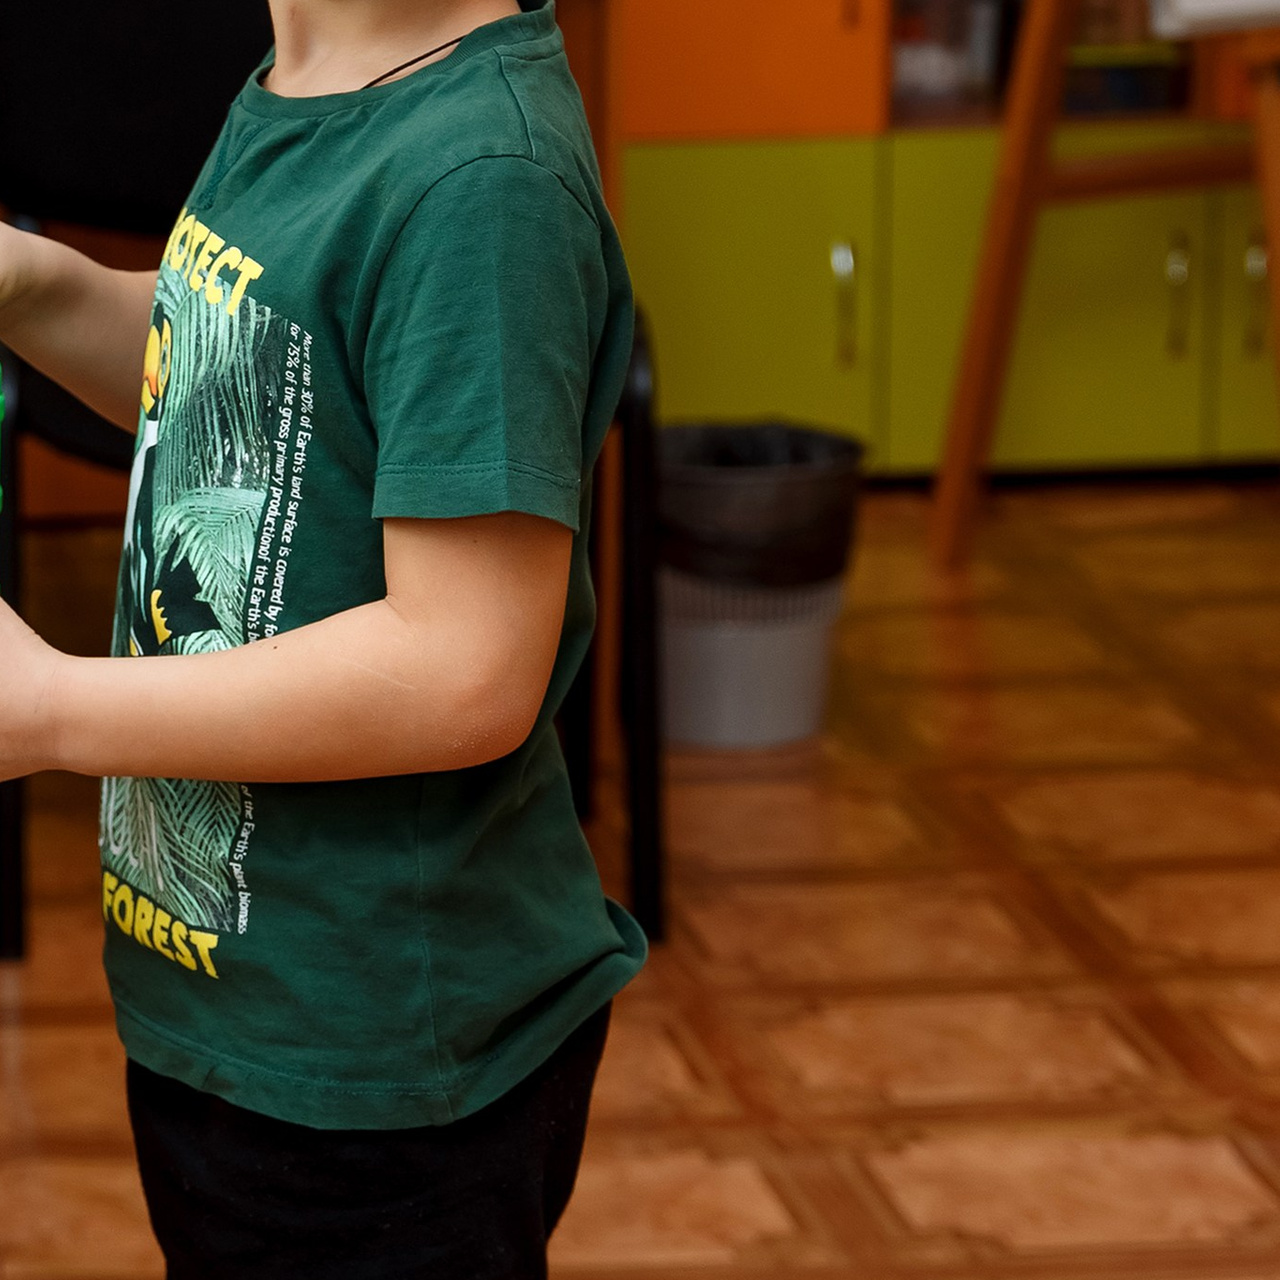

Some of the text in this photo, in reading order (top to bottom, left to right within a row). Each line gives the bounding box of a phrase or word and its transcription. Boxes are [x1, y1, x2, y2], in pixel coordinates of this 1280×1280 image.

[289, 322, 300, 341] for
[286, 341, 299, 369] 75%
[302, 330, 313, 361] More
[284, 370, 296, 385] of
[302, 363, 312, 386] than
[283, 386, 295, 405] the
[300, 387, 313, 414] 30%
[278, 405, 292, 440] gross
[299, 415, 312, 430] of
[271, 440, 287, 486] primary
[292, 430, 311, 474] Earth's
[290, 475, 302, 500] land
[281, 500, 298, 544] surface
[278, 546, 291, 557] is
[253, 564, 268, 586] the
[270, 558, 286, 605] covered
[246, 587, 265, 630] Earth's
[263, 604, 282, 622] by
[229, 784, 254, 935] of the Earth's plant biomass
[102, 871, 219, 980] FOREST
